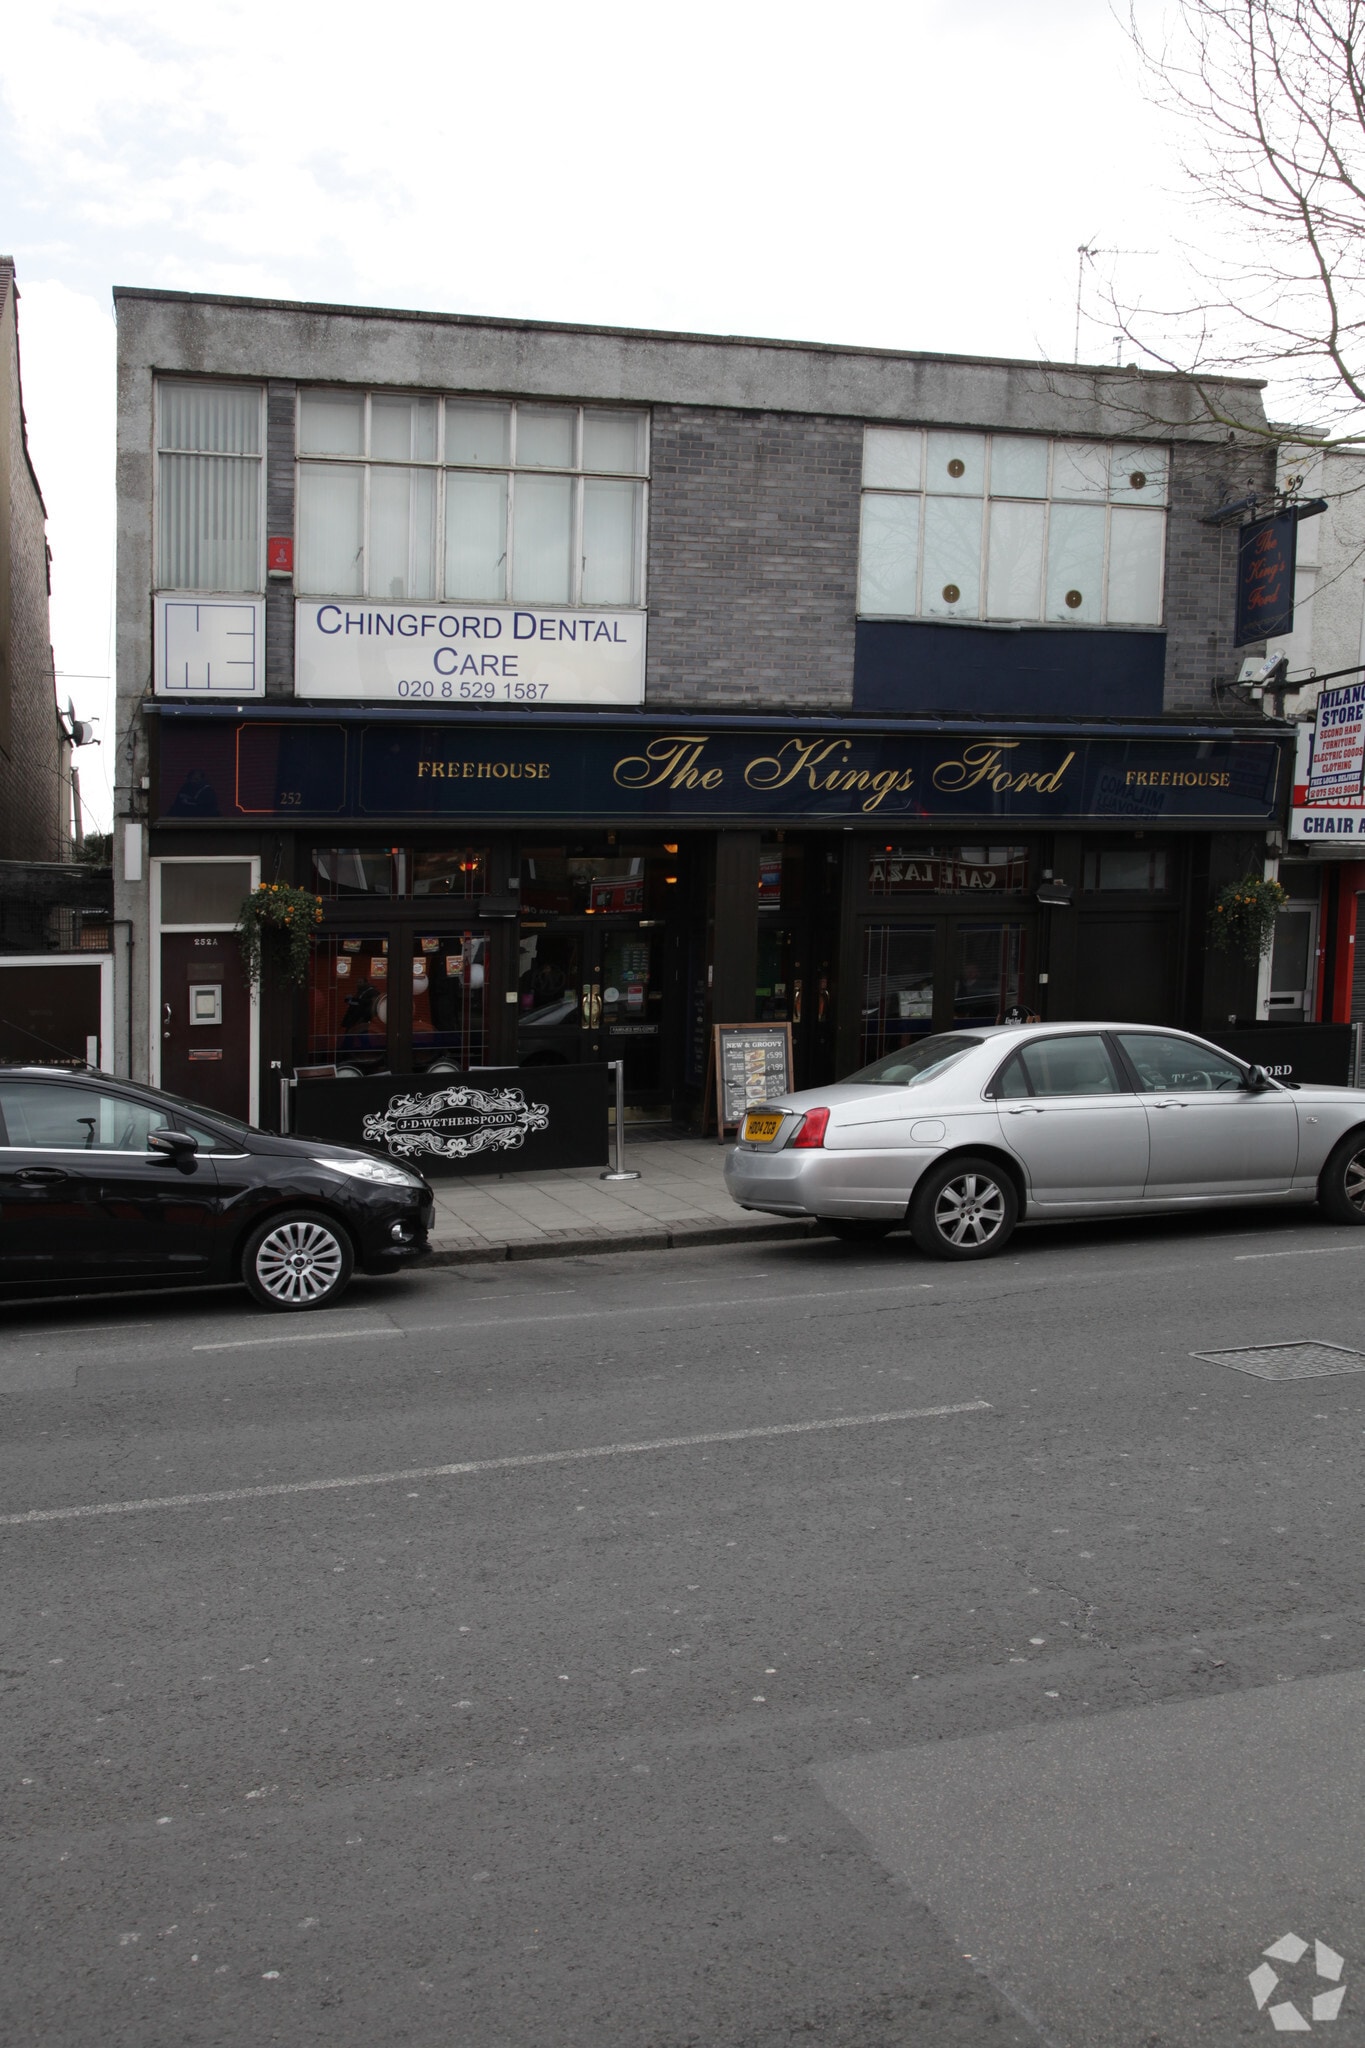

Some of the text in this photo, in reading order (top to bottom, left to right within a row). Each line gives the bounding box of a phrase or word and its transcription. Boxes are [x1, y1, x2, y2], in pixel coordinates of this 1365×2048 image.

[1255, 529, 1277, 553] The
[1245, 552, 1286, 584] King's
[1247, 583, 1281, 610] Ford
[316, 605, 627, 643] CHINGFORD DENTAL
[433, 647, 519, 677] CARE
[398, 680, 549, 700] 020 8 529 1587
[1321, 703, 1364, 728] STORE
[1320, 723, 1361, 740] SECOND HAND
[1322, 737, 1356, 750] FURNITURE
[1313, 747, 1363, 763] ELECTRIC GOODS
[417, 761, 551, 780] FREEHOUSE
[613, 736, 1076, 812] The Kings Ford
[1322, 761, 1352, 773] CLOTHING
[1126, 770, 1232, 788] FREEHOUSE
[1323, 775, 1337, 784] LOCAL
[1338, 772, 1360, 782] DELIVERY
[280, 791, 303, 805] 252
[1303, 817, 1353, 833] CHAIR
[1264, 1064, 1293, 1076] ORD
